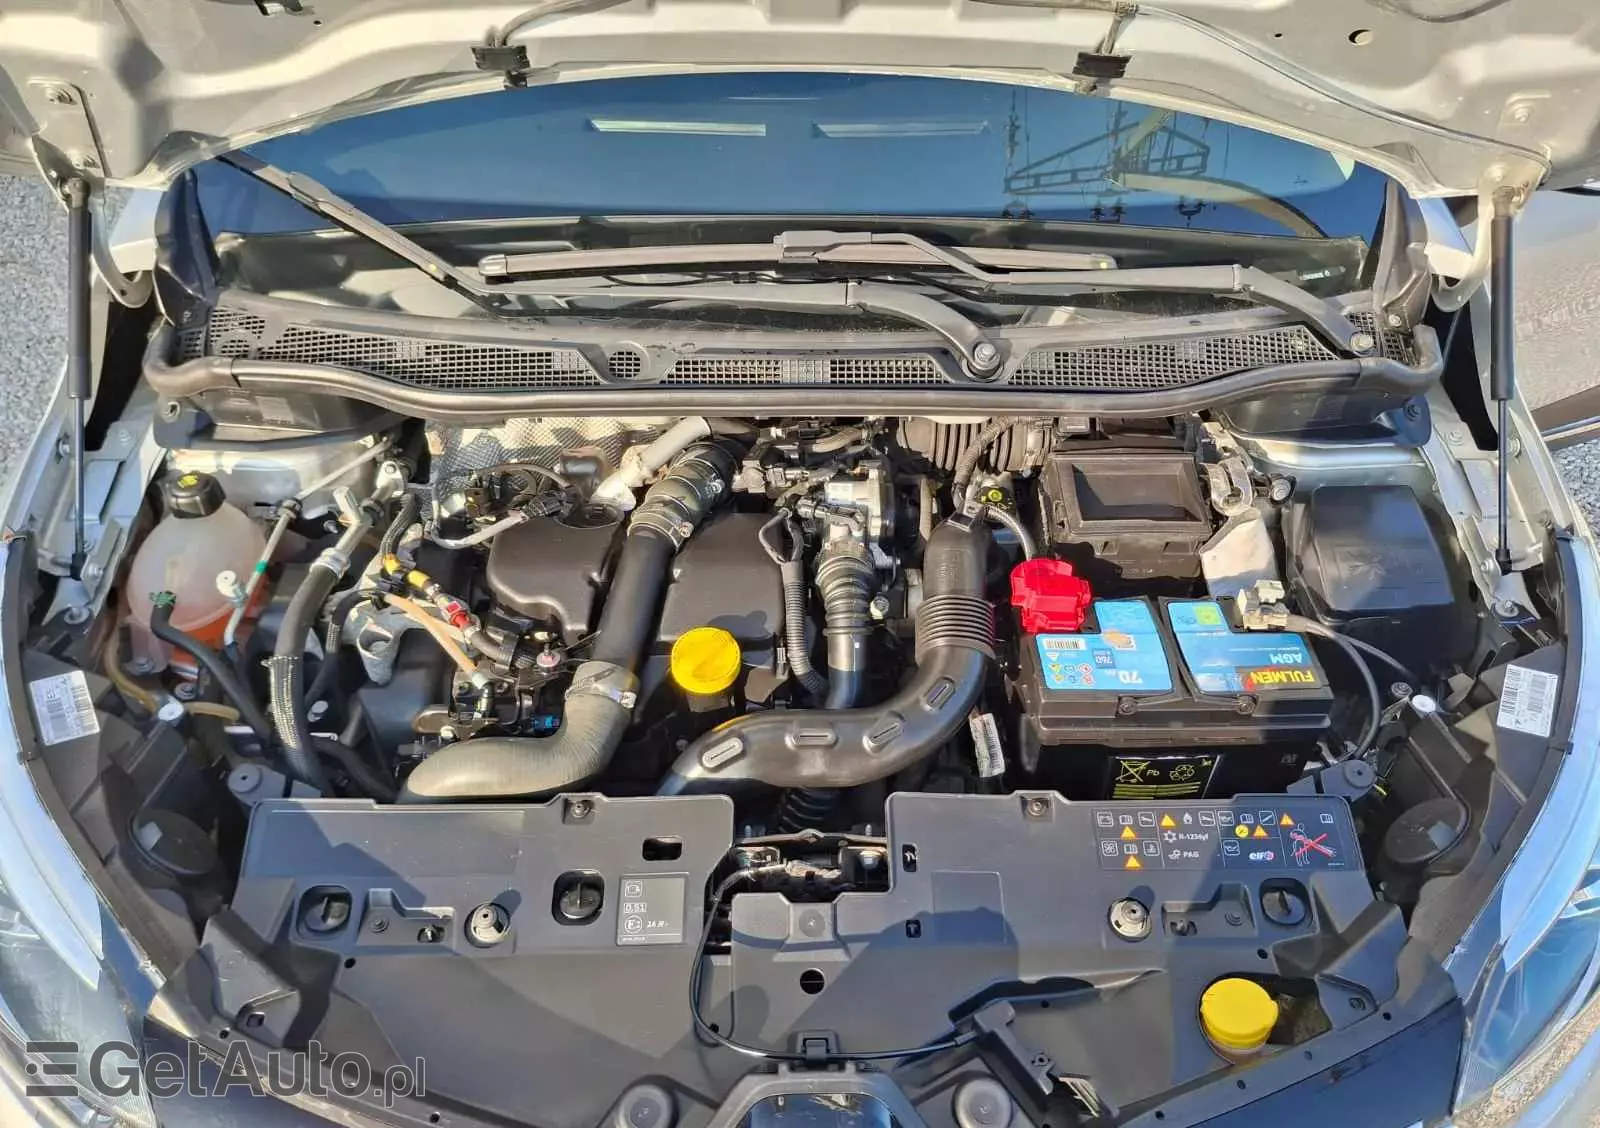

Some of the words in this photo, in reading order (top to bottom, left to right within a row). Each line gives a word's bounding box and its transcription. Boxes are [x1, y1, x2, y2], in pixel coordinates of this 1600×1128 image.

[1269, 653, 1303, 665] AGM
[1119, 669, 1143, 685] 70
[1250, 669, 1316, 685] FULMEN
[1146, 768, 1160, 778] Pb
